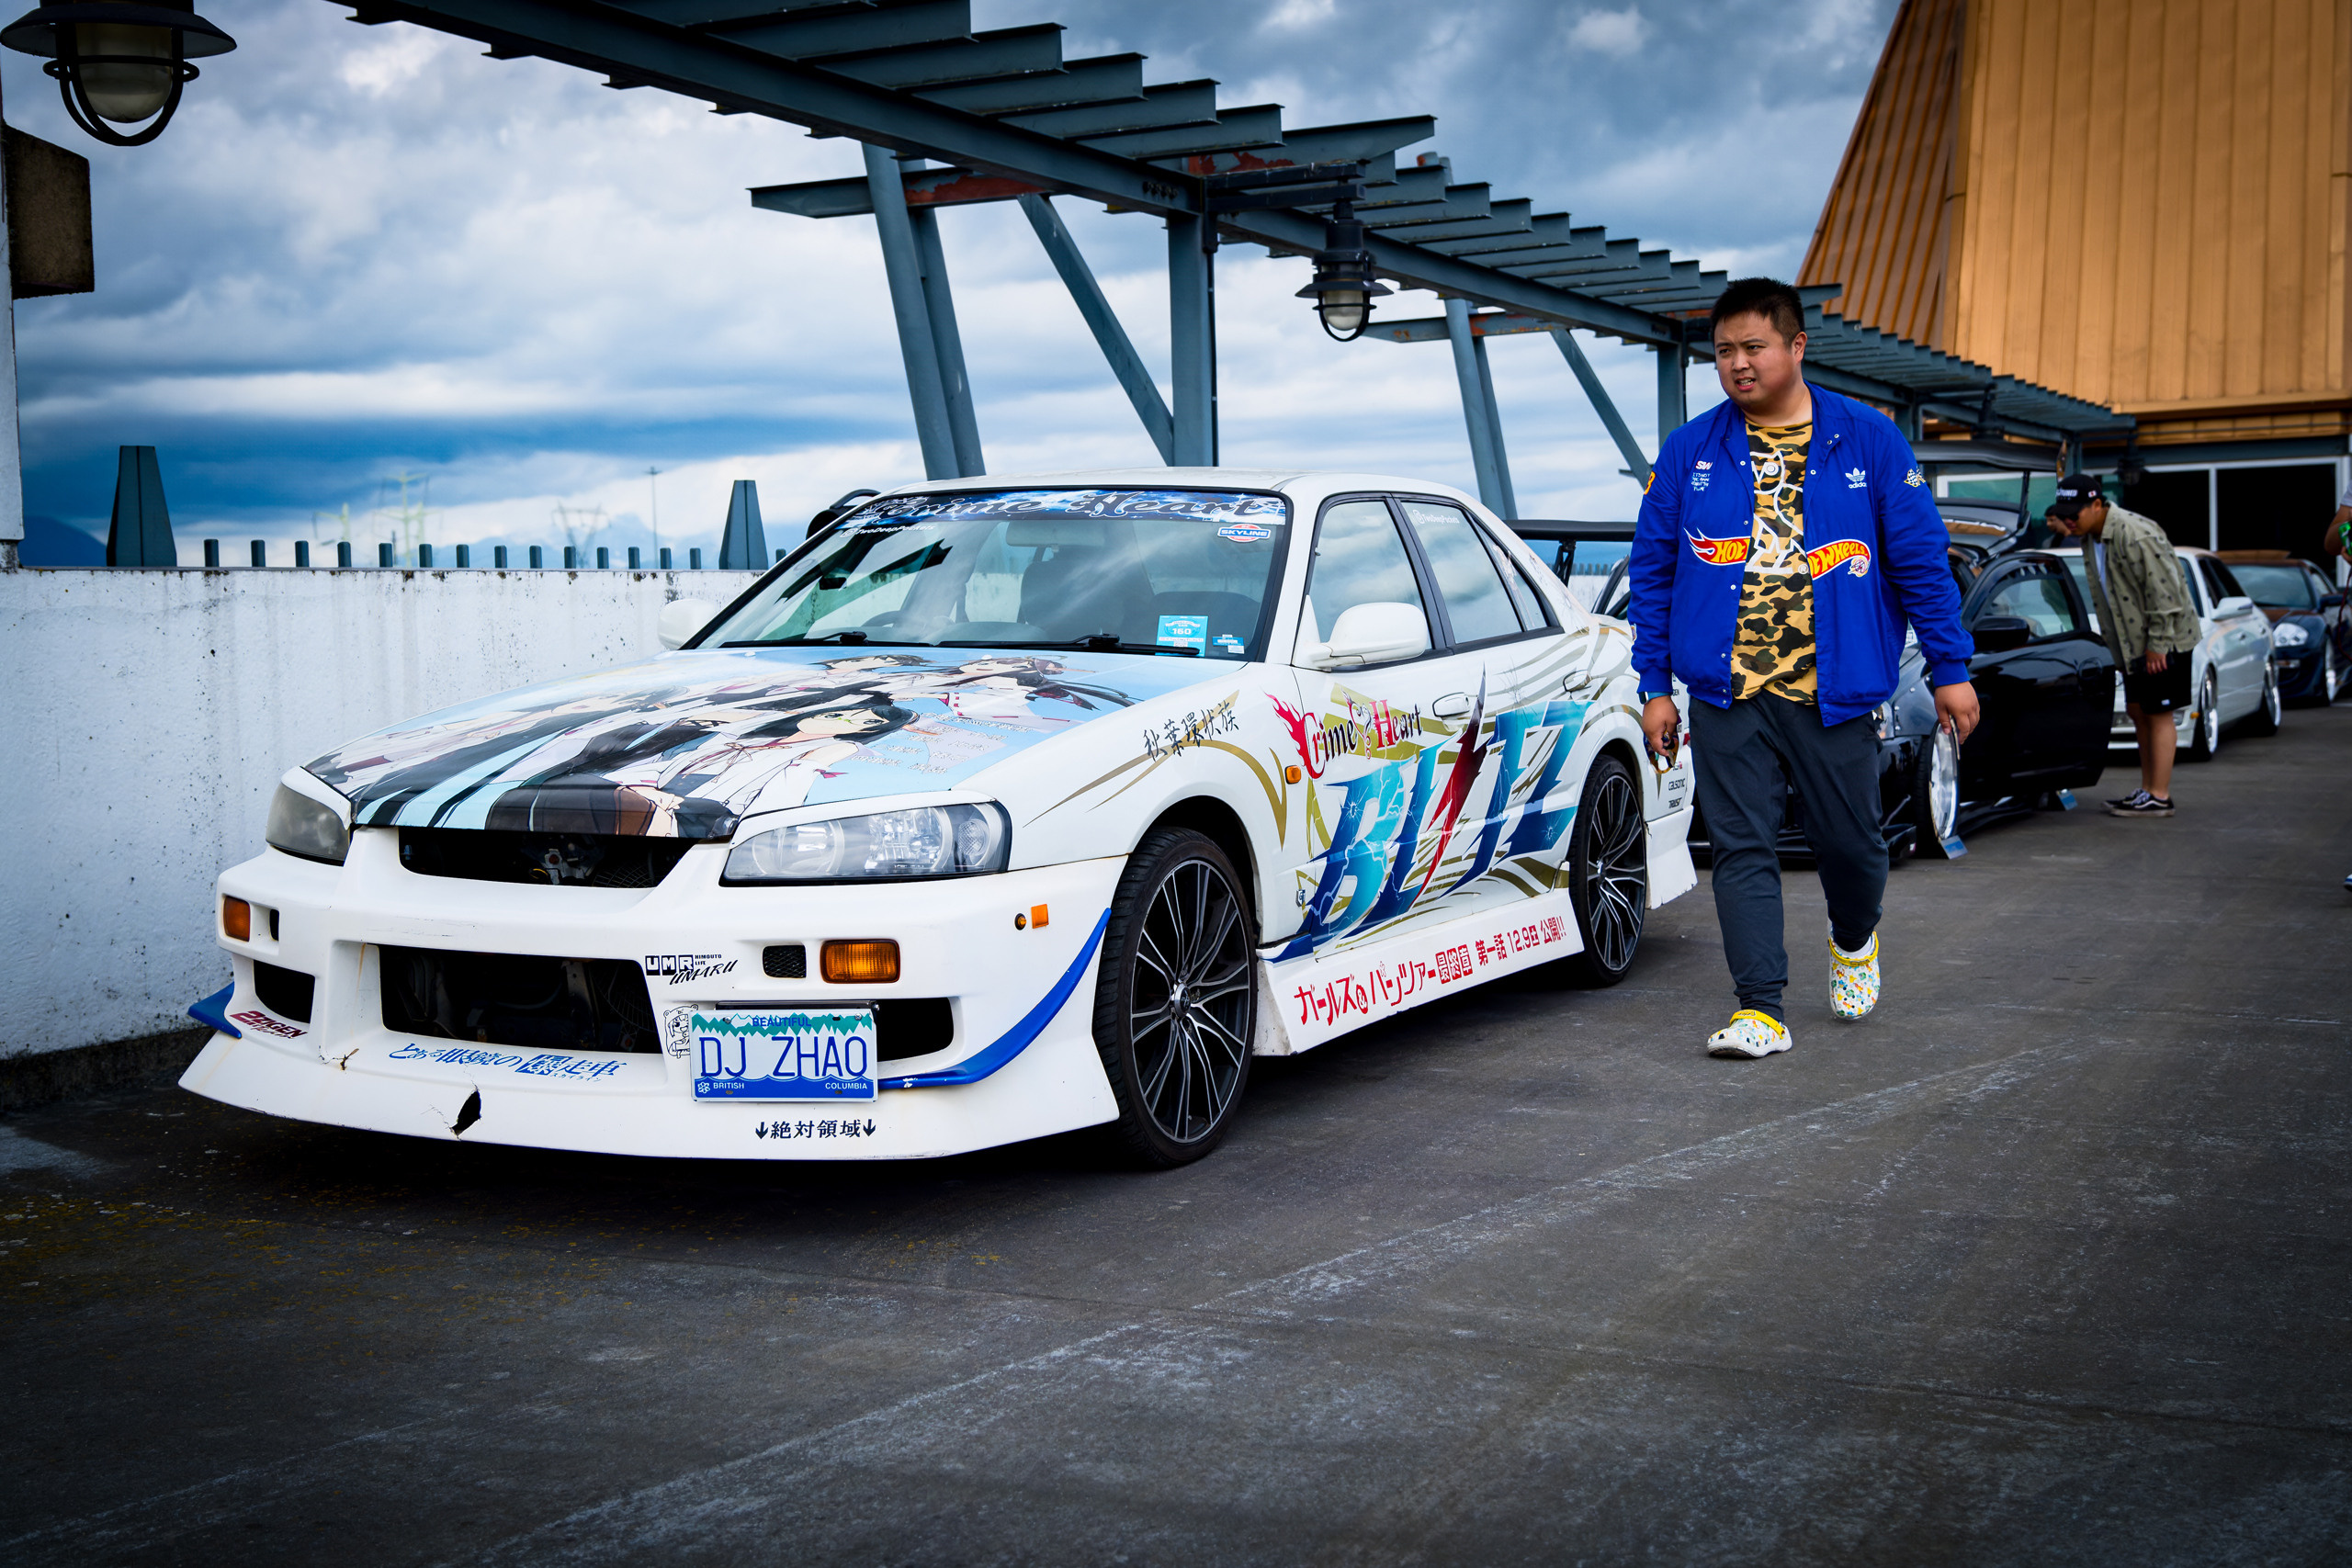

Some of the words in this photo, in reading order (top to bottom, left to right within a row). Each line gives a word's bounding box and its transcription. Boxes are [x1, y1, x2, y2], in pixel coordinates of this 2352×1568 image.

[1065, 491, 1264, 518] Heart
[1220, 529, 1269, 537] SKYLINE
[1369, 699, 1423, 750] Heart
[1475, 932, 1508, 966] 第一話
[645, 954, 695, 976] UMR
[669, 959, 739, 986] UMARU
[752, 1017, 812, 1027] BEAUTIFUL
[699, 1036, 747, 1077] DJ
[771, 1035, 868, 1077] ZHAO
[713, 1082, 745, 1090] BRITISH
[824, 1082, 868, 1090] COLUMBIA
[770, 1119, 862, 1140] 絶対領域
